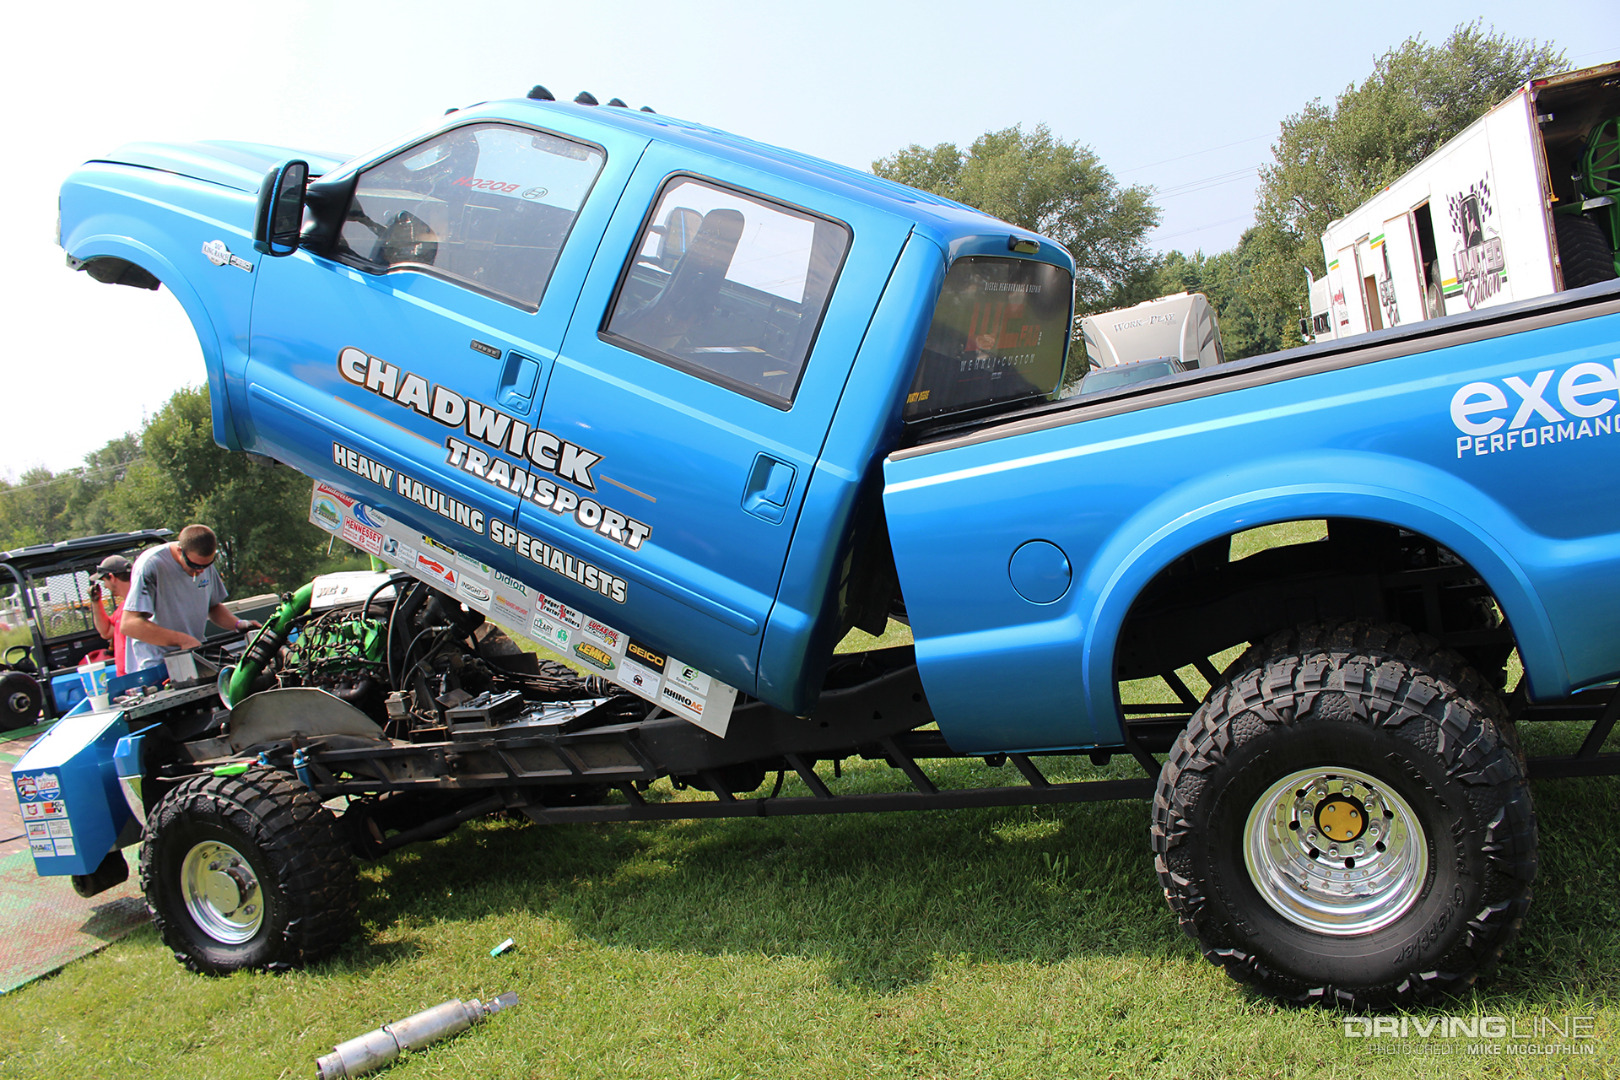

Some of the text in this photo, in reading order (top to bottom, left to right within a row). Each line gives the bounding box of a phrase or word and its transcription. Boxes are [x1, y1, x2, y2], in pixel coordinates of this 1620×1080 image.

[1453, 236, 1505, 284] LIMITED
[1450, 358, 1620, 436] exe
[337, 346, 605, 493] CHADWICK
[445, 437, 653, 551] TRANSPORT
[332, 441, 629, 604] HEAVY HAULING SPECIALISTS
[345, 518, 383, 545] HENNESSEY
[494, 569, 526, 596] Didion
[538, 593, 560, 610] Badger
[559, 604, 576, 618] State
[540, 601, 560, 617] Tractor
[559, 611, 580, 628] Pullers
[589, 620, 618, 640] LUCAS OIL
[577, 641, 612, 665] LEMKE
[628, 643, 664, 667] GEICO
[675, 676, 699, 692] Spark Plugs
